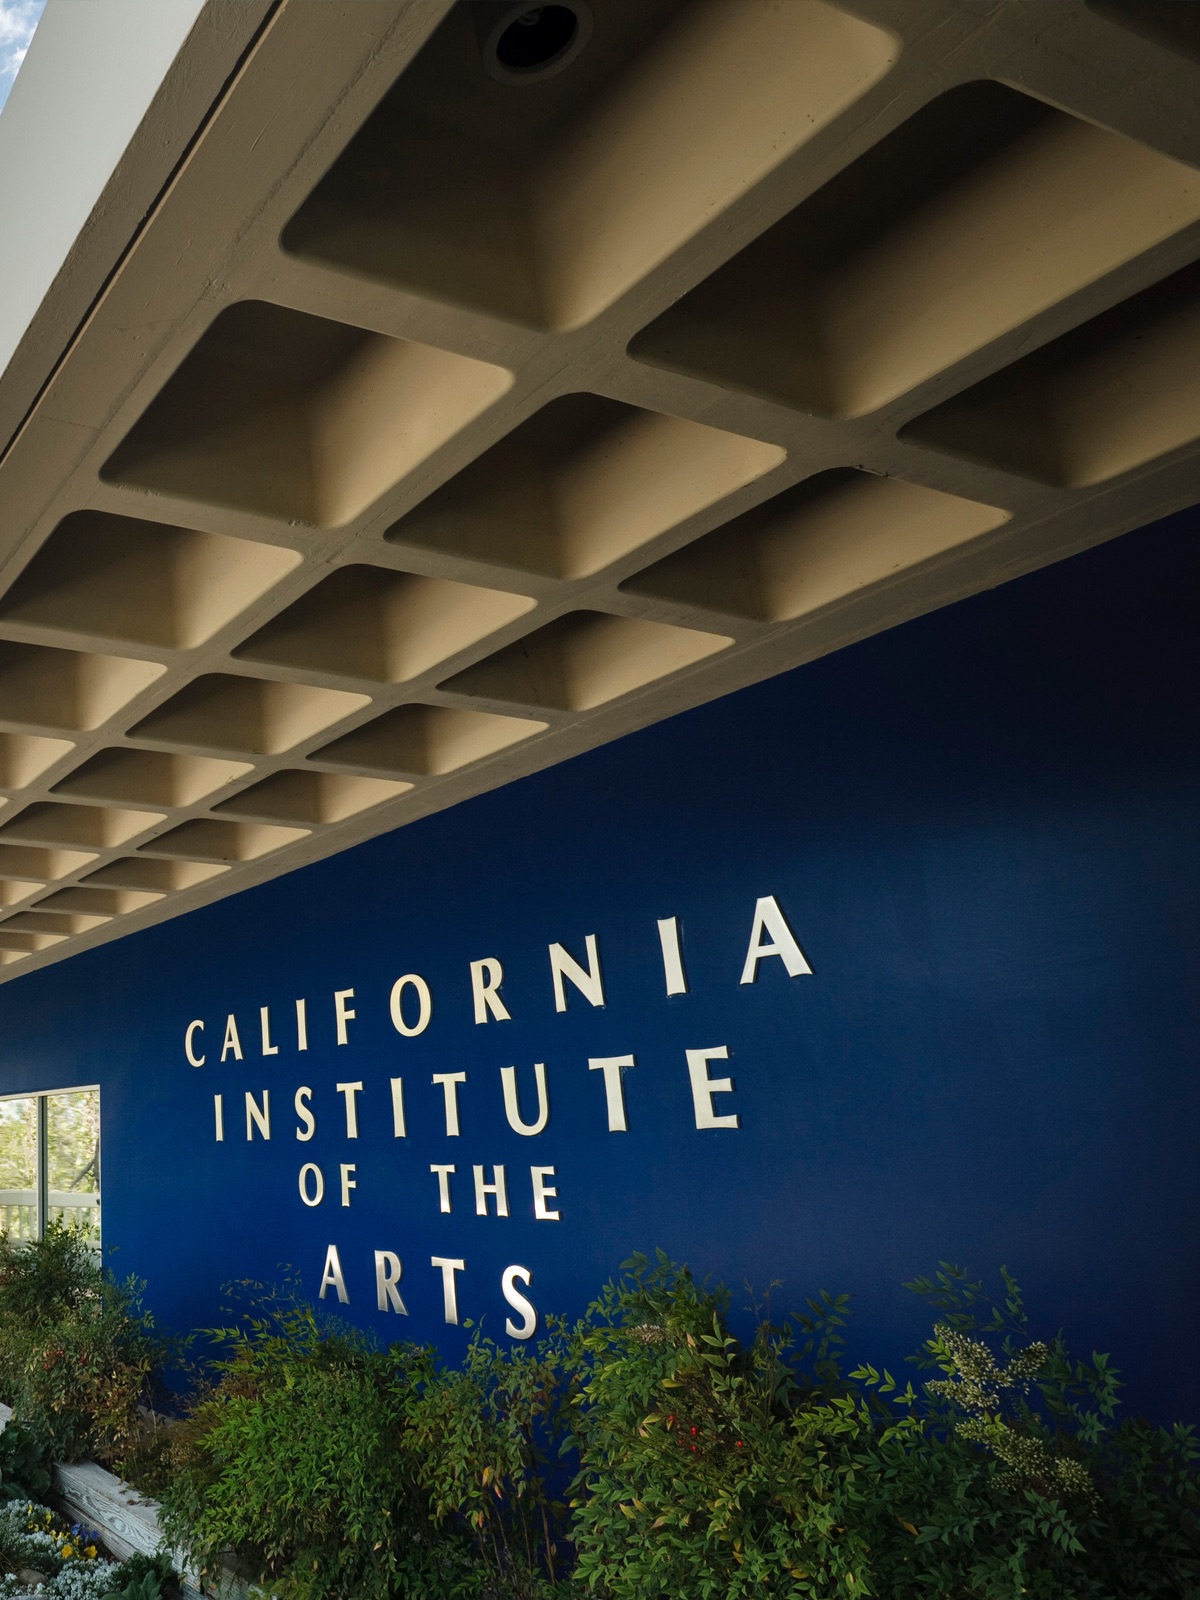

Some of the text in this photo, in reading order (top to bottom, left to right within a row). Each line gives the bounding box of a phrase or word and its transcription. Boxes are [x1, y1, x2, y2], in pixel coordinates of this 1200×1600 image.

[184, 894, 813, 1068] CALIFORNIA
[214, 1045, 739, 1142] INSTITUTE
[298, 1162, 560, 1221] OF THE
[318, 1244, 538, 1340] ARTS
